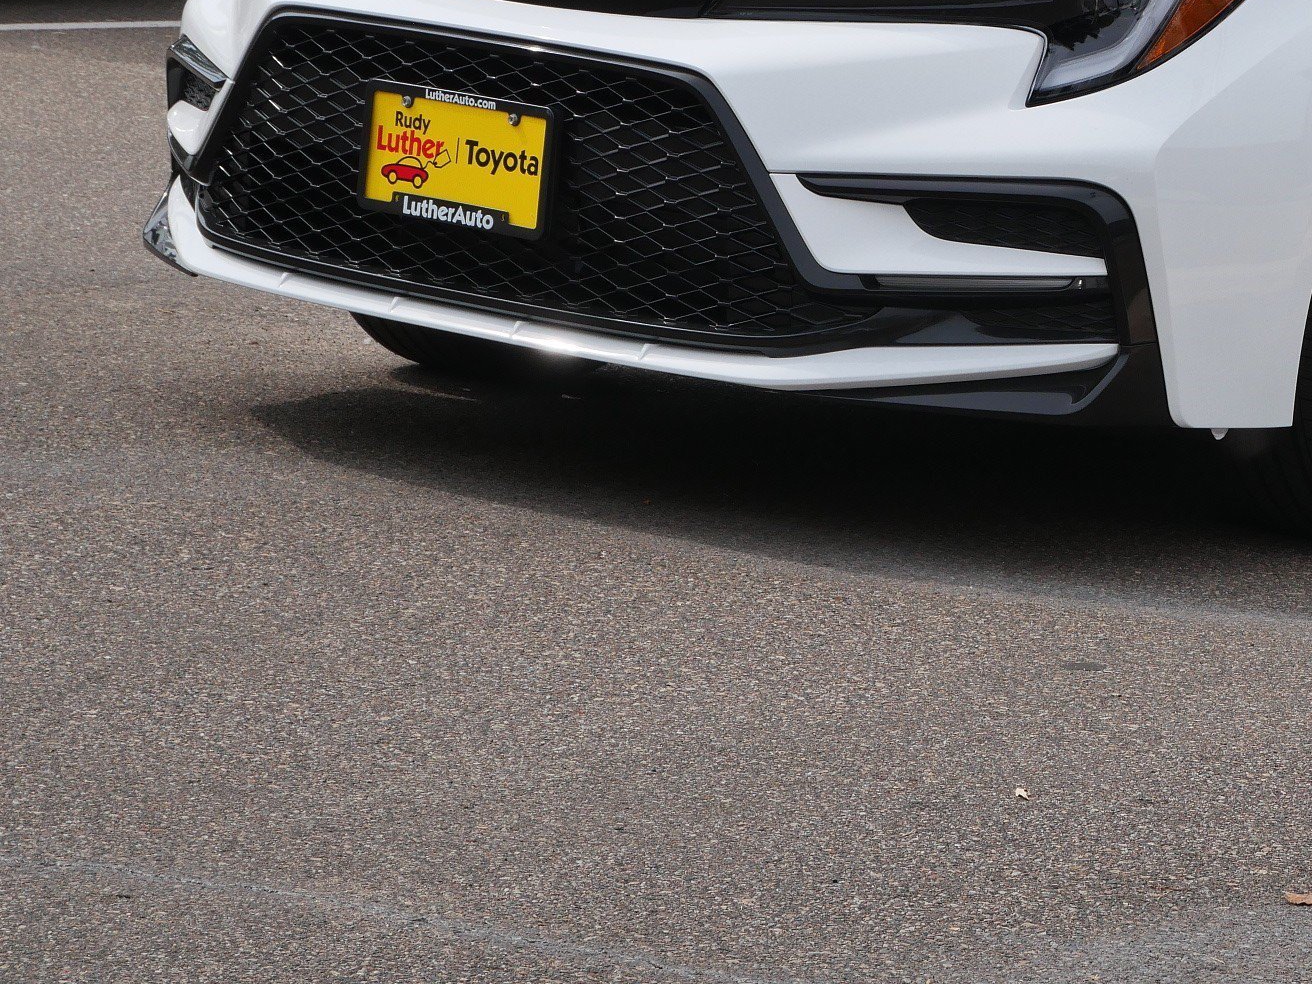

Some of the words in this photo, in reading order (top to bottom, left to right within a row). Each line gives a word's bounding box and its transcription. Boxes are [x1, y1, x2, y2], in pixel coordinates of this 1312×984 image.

[425, 88, 497, 111] LutherAuto.com
[394, 110, 432, 135] Rudy
[376, 124, 445, 159] Luther
[464, 138, 539, 177] Toyota
[402, 195, 495, 230] LutherAuto
